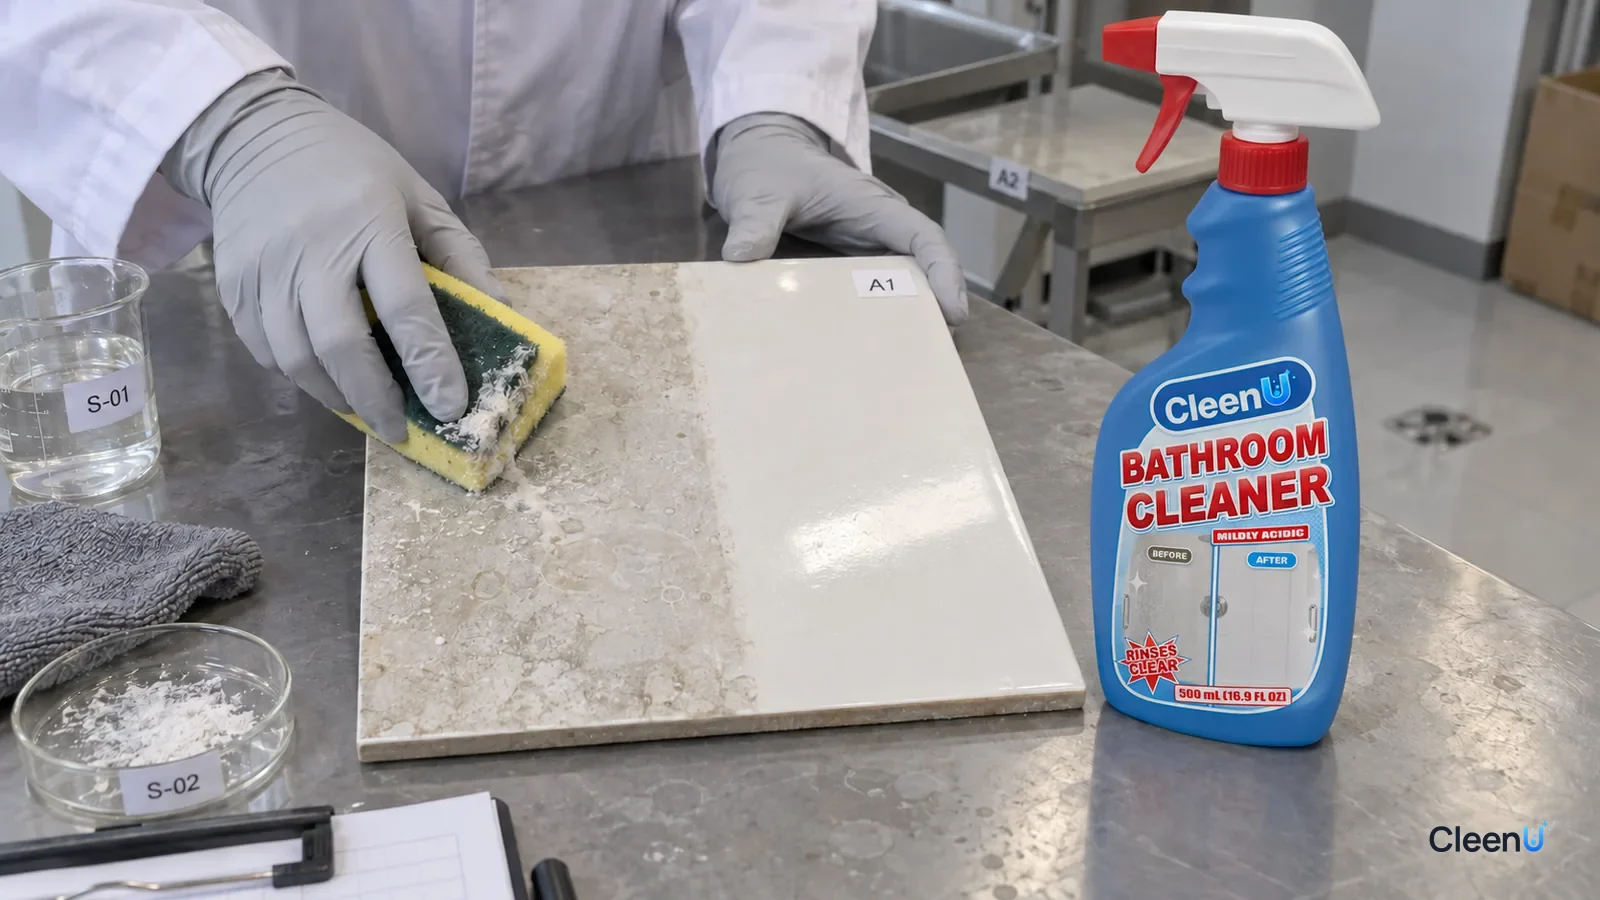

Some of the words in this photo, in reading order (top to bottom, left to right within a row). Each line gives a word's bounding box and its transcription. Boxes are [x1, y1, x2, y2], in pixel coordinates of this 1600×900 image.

[996, 168, 1019, 188] A2
[869, 278, 894, 291] A1
[87, 385, 129, 413] S-01
[1165, 371, 1292, 424] CleenU
[1122, 420, 1327, 485] BATHROOM
[1127, 466, 1331, 529] CLEANER
[1217, 531, 1258, 541] MILDLY
[1261, 529, 1304, 539] ACIDIC
[1152, 550, 1188, 560] BEFORE
[1256, 555, 1288, 564] AFTER
[1126, 644, 1177, 661] RINSES
[1130, 659, 1179, 675] CLEAR
[1179, 688, 1201, 699] 500
[1203, 690, 1220, 700] mL
[1223, 690, 1252, 701] (16.9
[1254, 691, 1266, 701] FL
[147, 773, 200, 800] S-02
